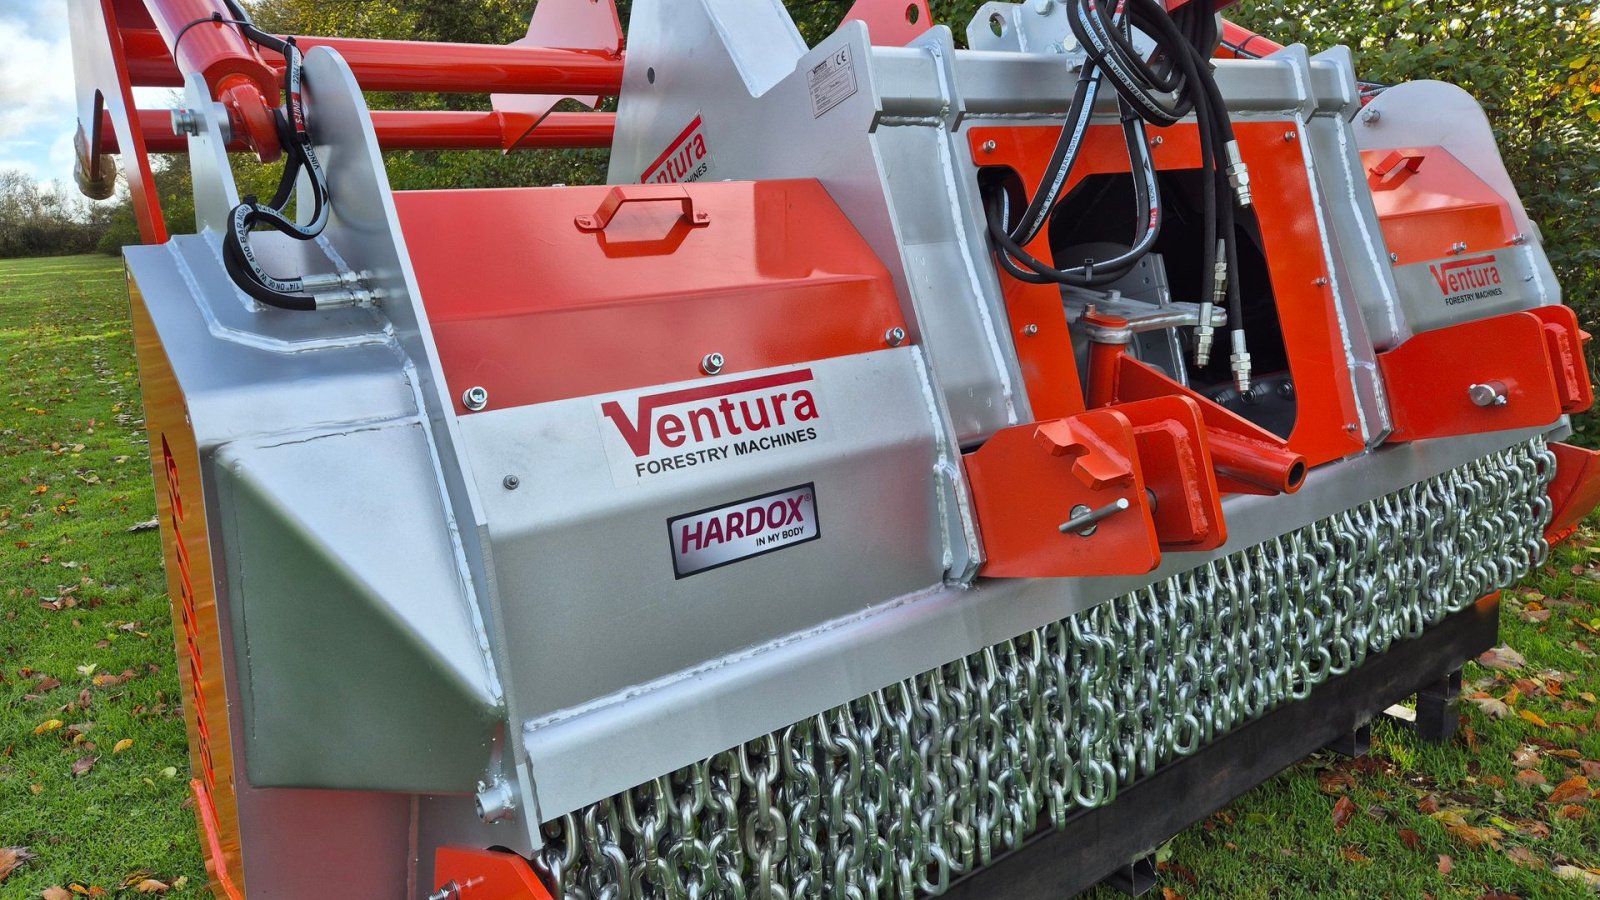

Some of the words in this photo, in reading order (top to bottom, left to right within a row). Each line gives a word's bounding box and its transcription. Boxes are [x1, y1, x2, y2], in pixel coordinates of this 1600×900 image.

[1113, 65, 1127, 82] MSHA
[1127, 83, 1139, 94] BAR
[292, 99, 303, 125] S-LINE
[304, 144, 320, 170] VINCK
[640, 114, 707, 184] ntura
[684, 162, 708, 182] HINES
[236, 223, 248, 243] BAR
[243, 246, 255, 263] 400
[1429, 255, 1501, 295] Ventura
[1445, 293, 1474, 306] FORESTRY
[1474, 287, 1503, 300] MACHINES
[601, 368, 819, 457] Ventura
[635, 445, 730, 477] FORESTRY
[733, 427, 818, 456] MACHINES
[756, 537, 765, 547] IN
[768, 532, 781, 544] MY
[782, 526, 805, 539] BODY
